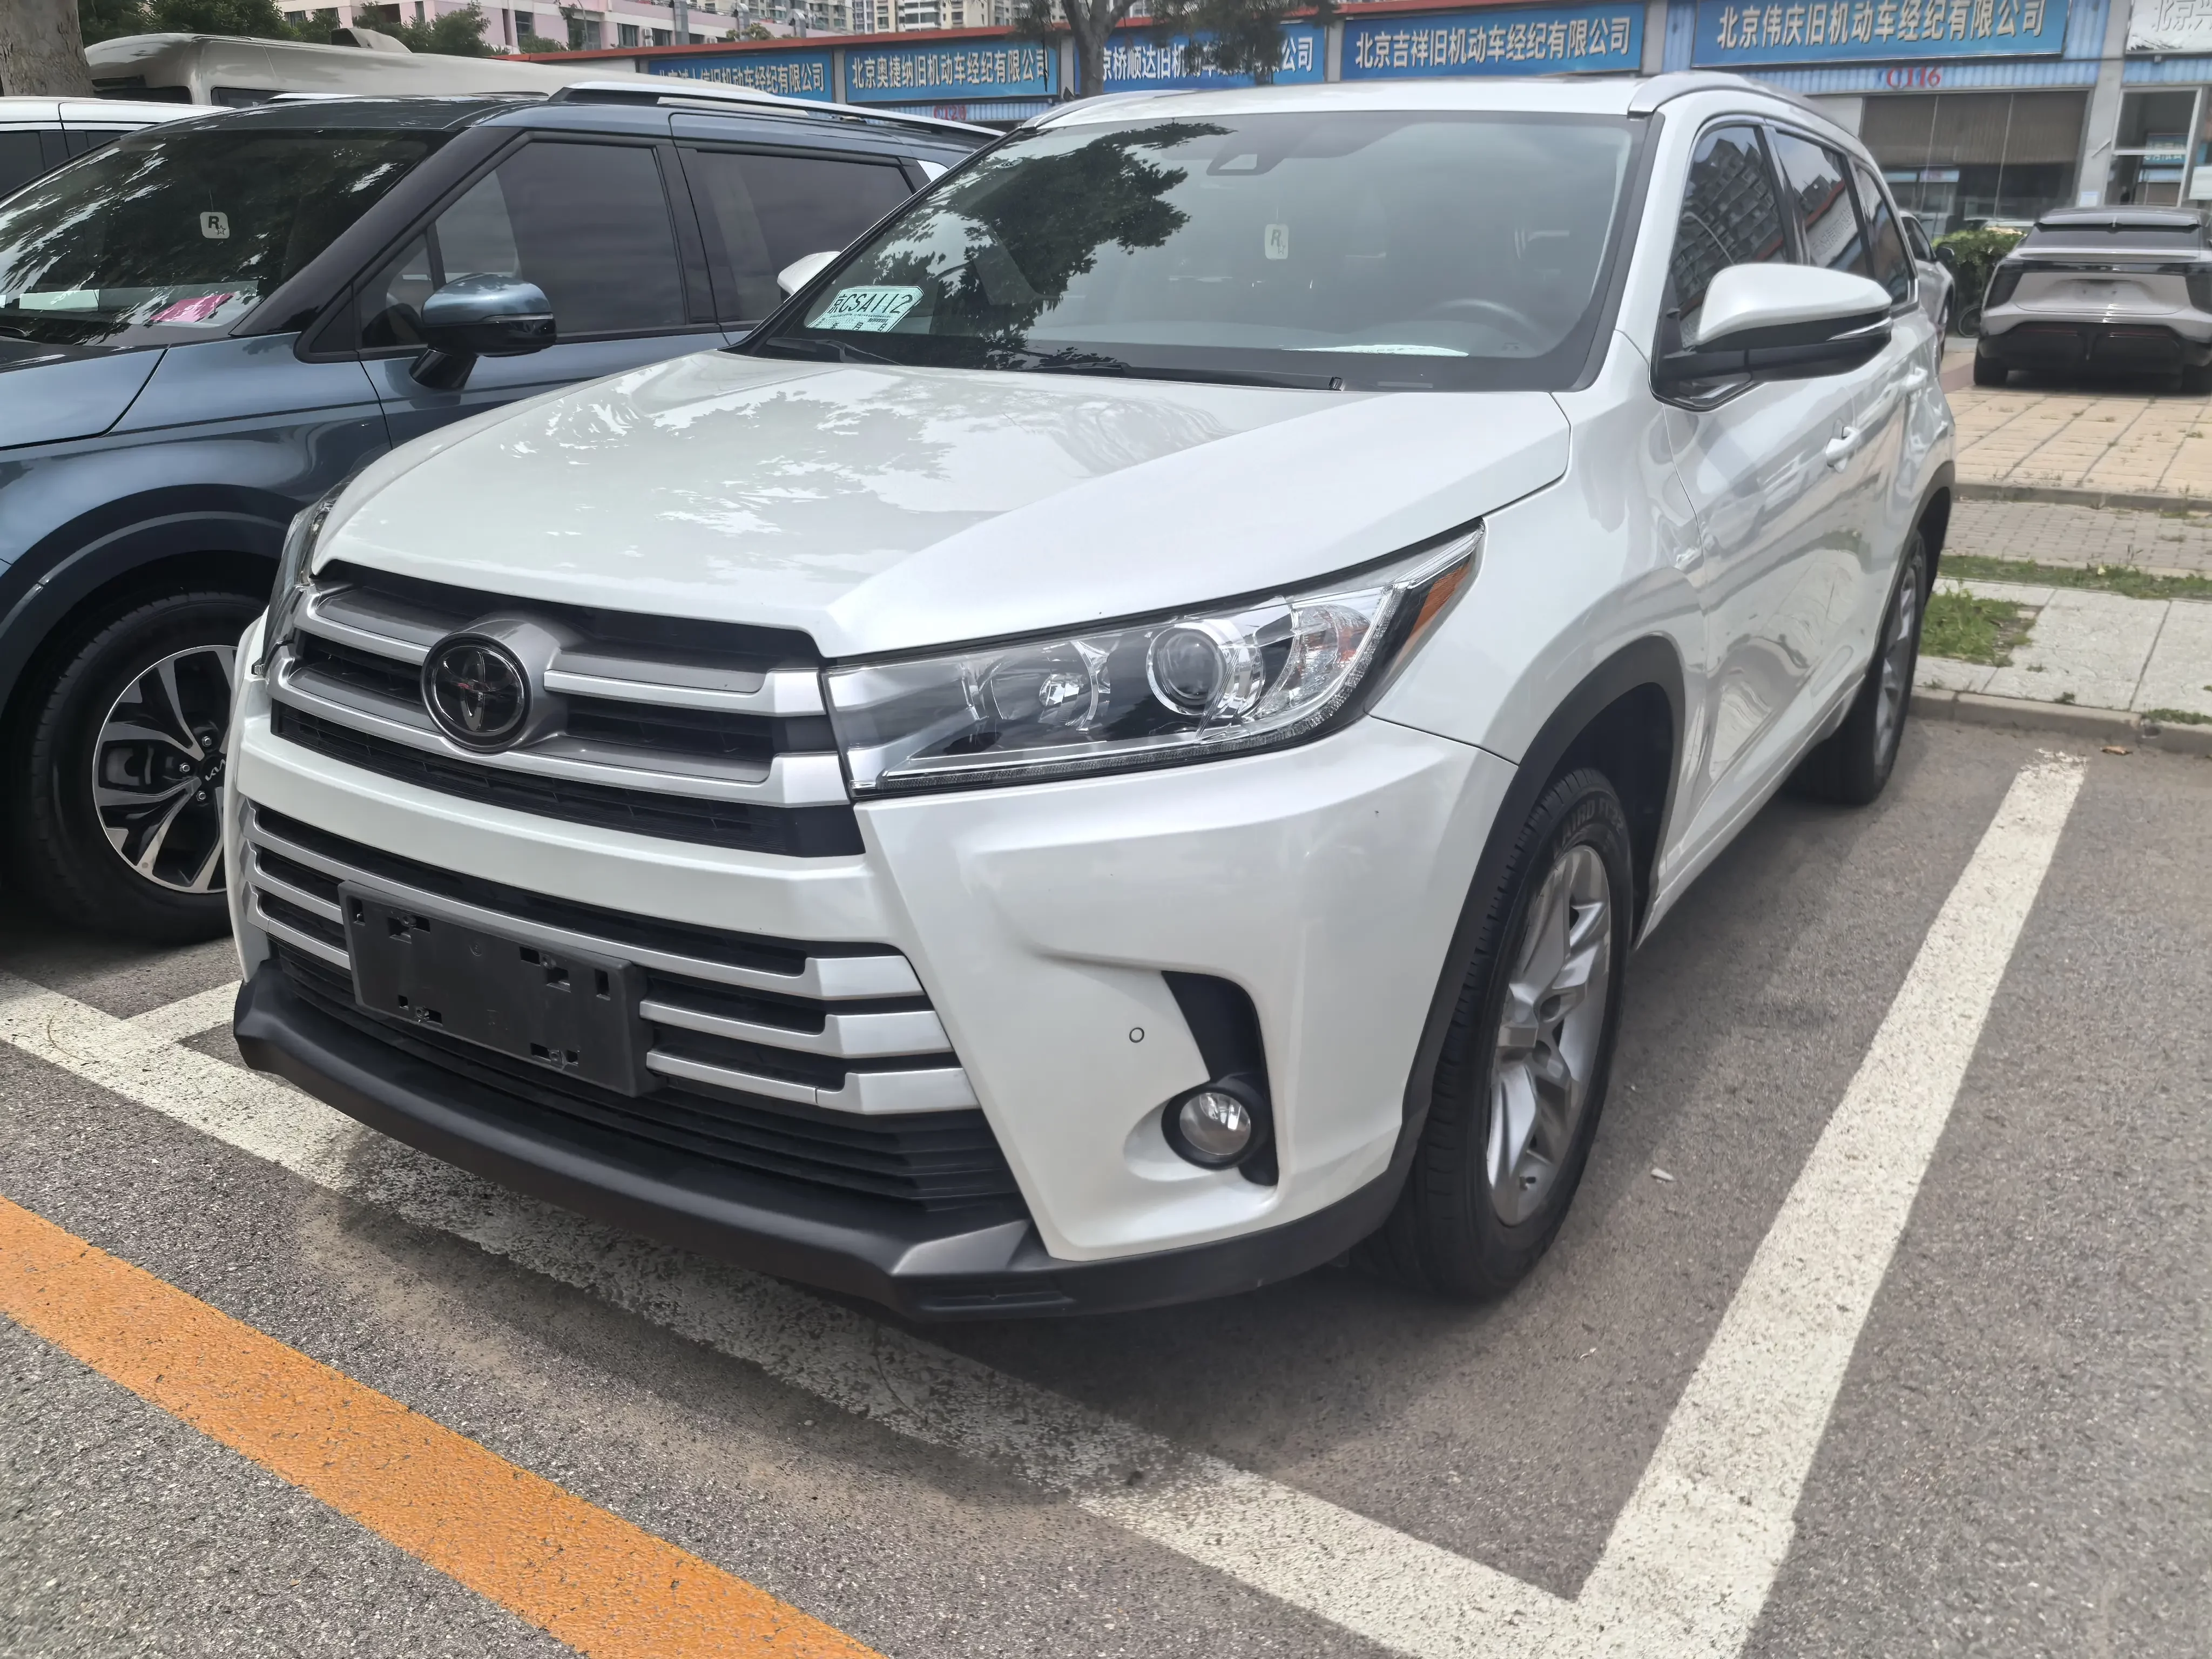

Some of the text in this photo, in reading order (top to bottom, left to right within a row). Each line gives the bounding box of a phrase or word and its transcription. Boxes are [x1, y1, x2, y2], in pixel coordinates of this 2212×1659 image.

[1354, 17, 1630, 69] 北京吉祥旧机动车经纪有限公司
[1717, 0, 2046, 49] 北京伟庆旧机动车经纪有限公司
[828, 293, 913, 314] 京CSA112
